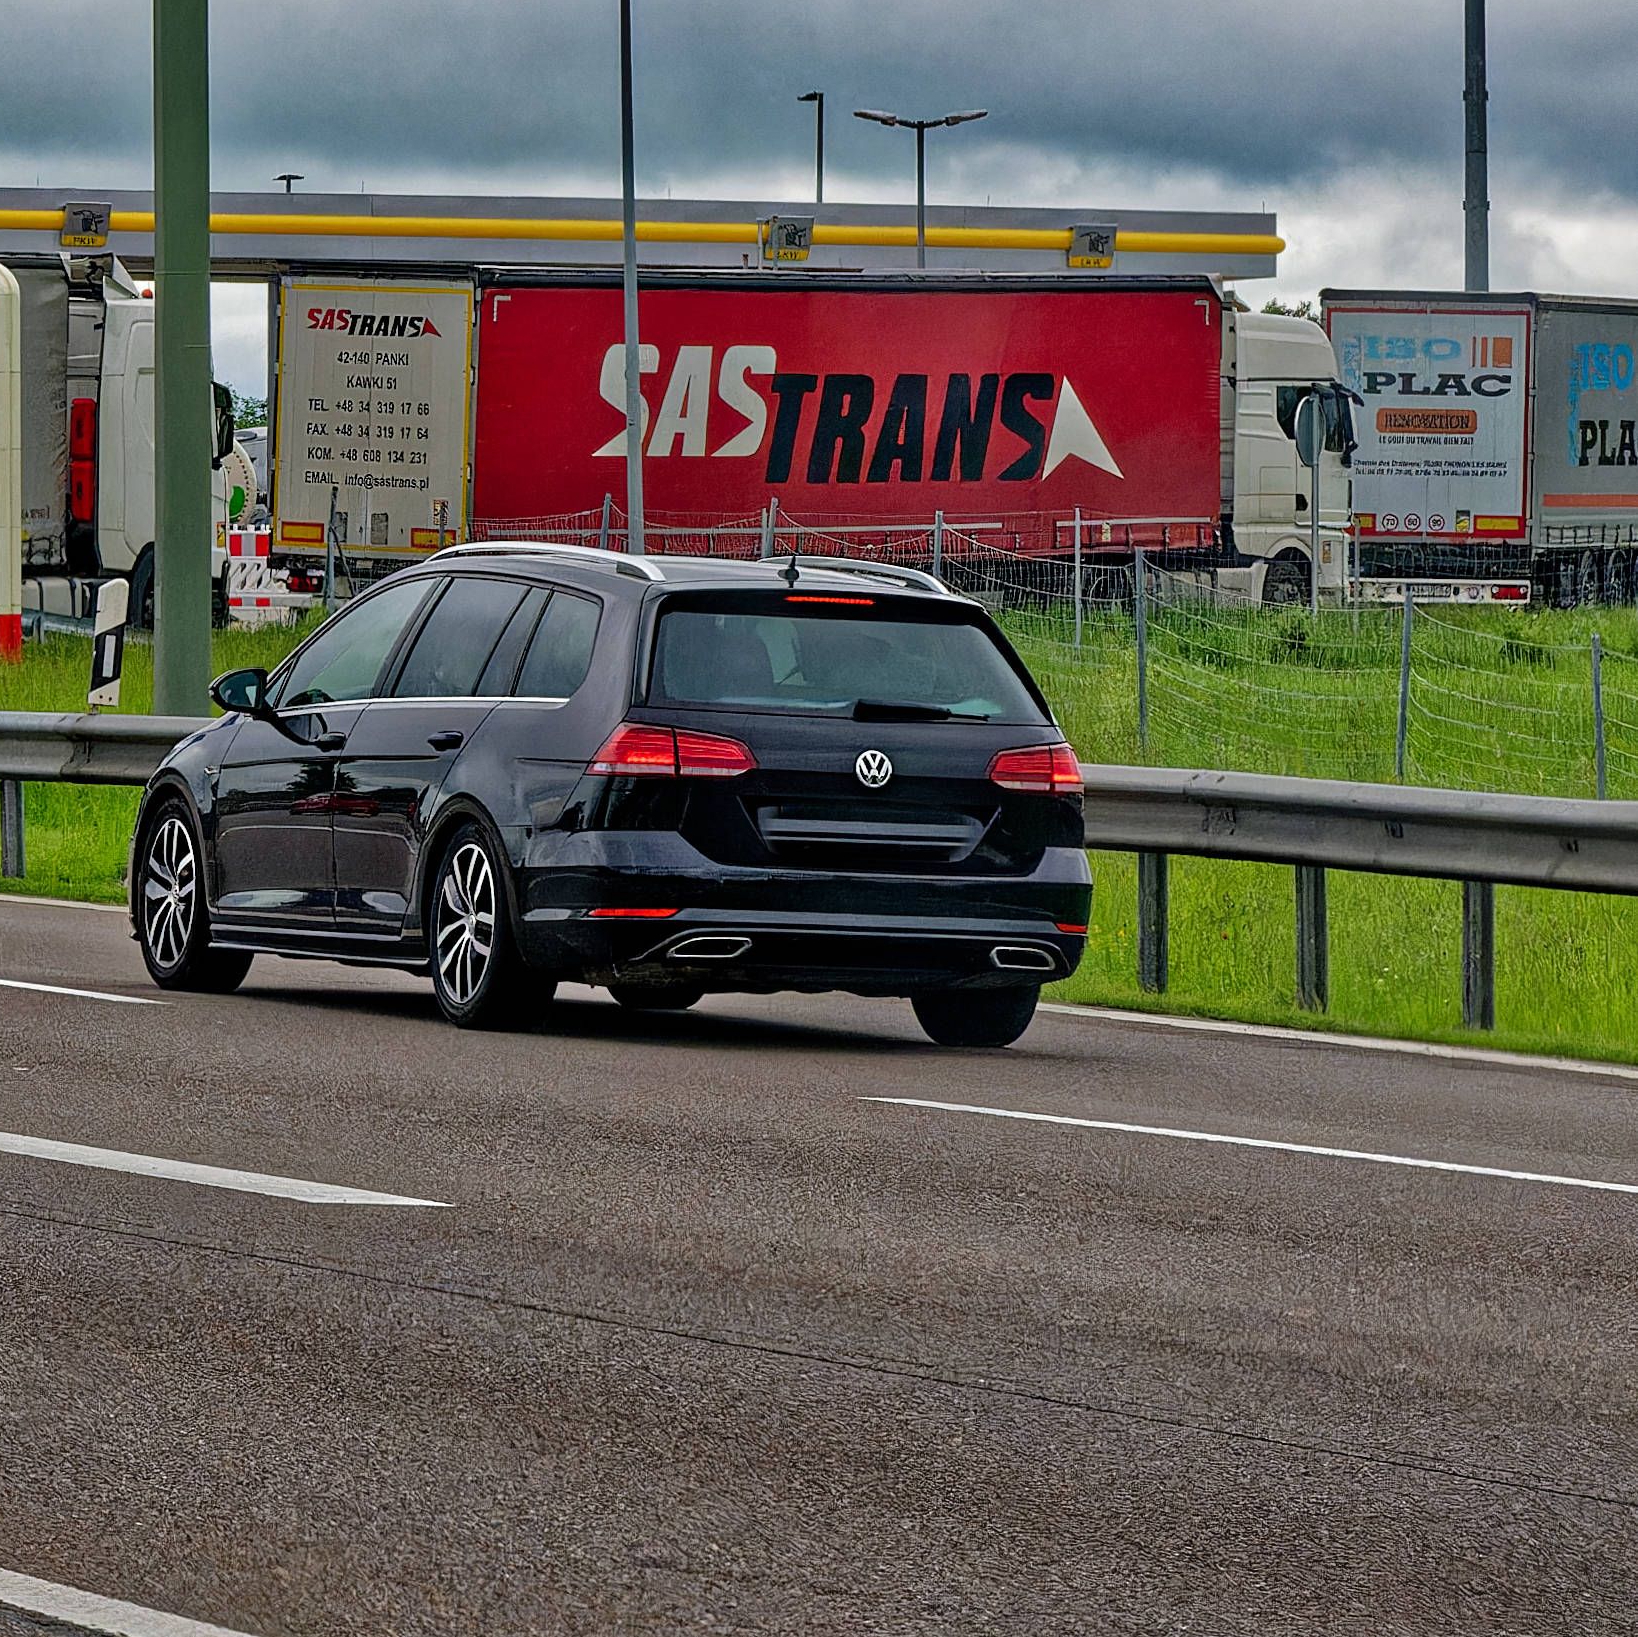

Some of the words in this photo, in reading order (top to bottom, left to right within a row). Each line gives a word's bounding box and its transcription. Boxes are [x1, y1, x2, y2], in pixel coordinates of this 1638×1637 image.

[307, 308, 424, 338] SASTRANS
[337, 351, 370, 365] 42-140
[375, 352, 409, 366] PANKI
[346, 375, 383, 389] KAWKI
[386, 377, 398, 390] 51
[1362, 372, 1512, 398] PLAC
[335, 399, 353, 413] +48
[358, 401, 370, 412] 34
[377, 401, 395, 414] 319
[401, 403, 411, 414] 17
[591, 343, 1054, 484] SASTRANS
[334, 423, 352, 437] +48
[358, 425, 370, 437] 34
[376, 425, 394, 439] 319
[401, 427, 411, 439] 17
[1578, 419, 1638, 467] PLA
[307, 447, 334, 460] KOM.
[340, 448, 358, 461] +48
[363, 450, 381, 462] 608
[387, 451, 404, 463] 134
[410, 452, 427, 464] 231
[345, 473, 430, 491] info@sastrans.pl
